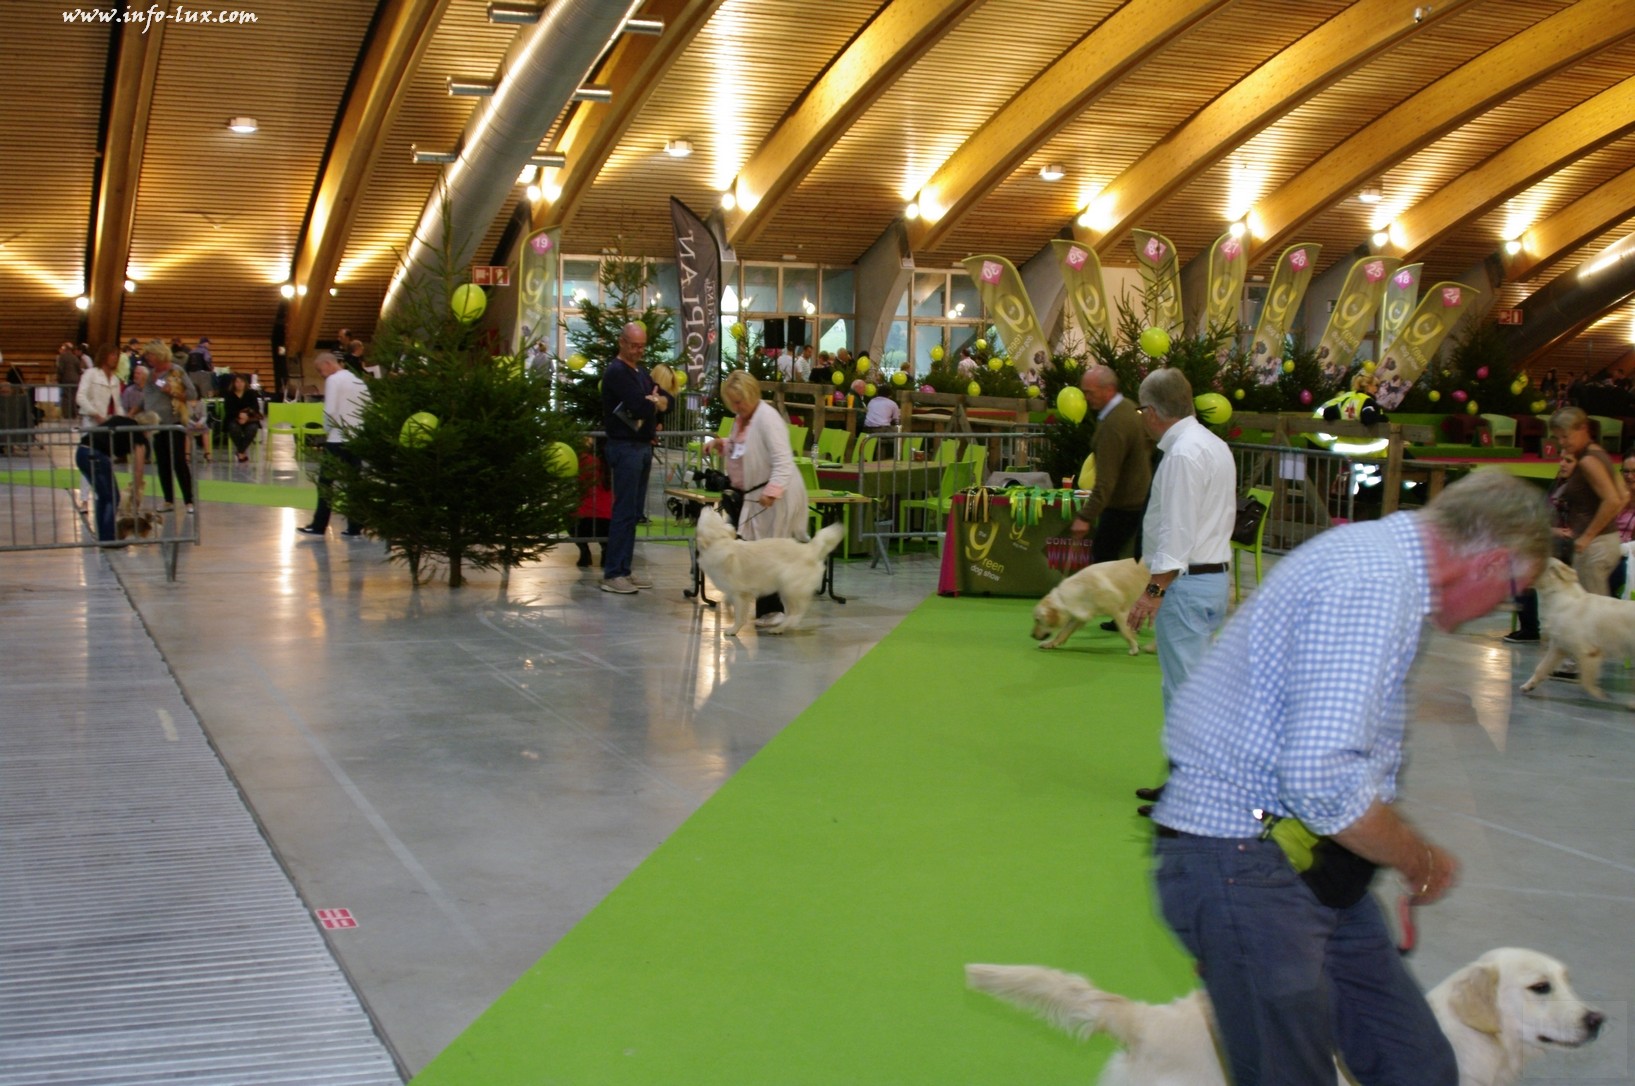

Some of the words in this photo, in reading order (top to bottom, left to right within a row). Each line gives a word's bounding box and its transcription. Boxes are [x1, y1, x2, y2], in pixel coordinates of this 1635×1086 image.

[534, 237, 548, 248] 19
[1223, 241, 1240, 254] 27
[1290, 252, 1306, 267] 26
[1366, 264, 1384, 278] 25
[1399, 275, 1410, 285] 18
[970, 564, 984, 577] dog
[984, 569, 1001, 583] show
